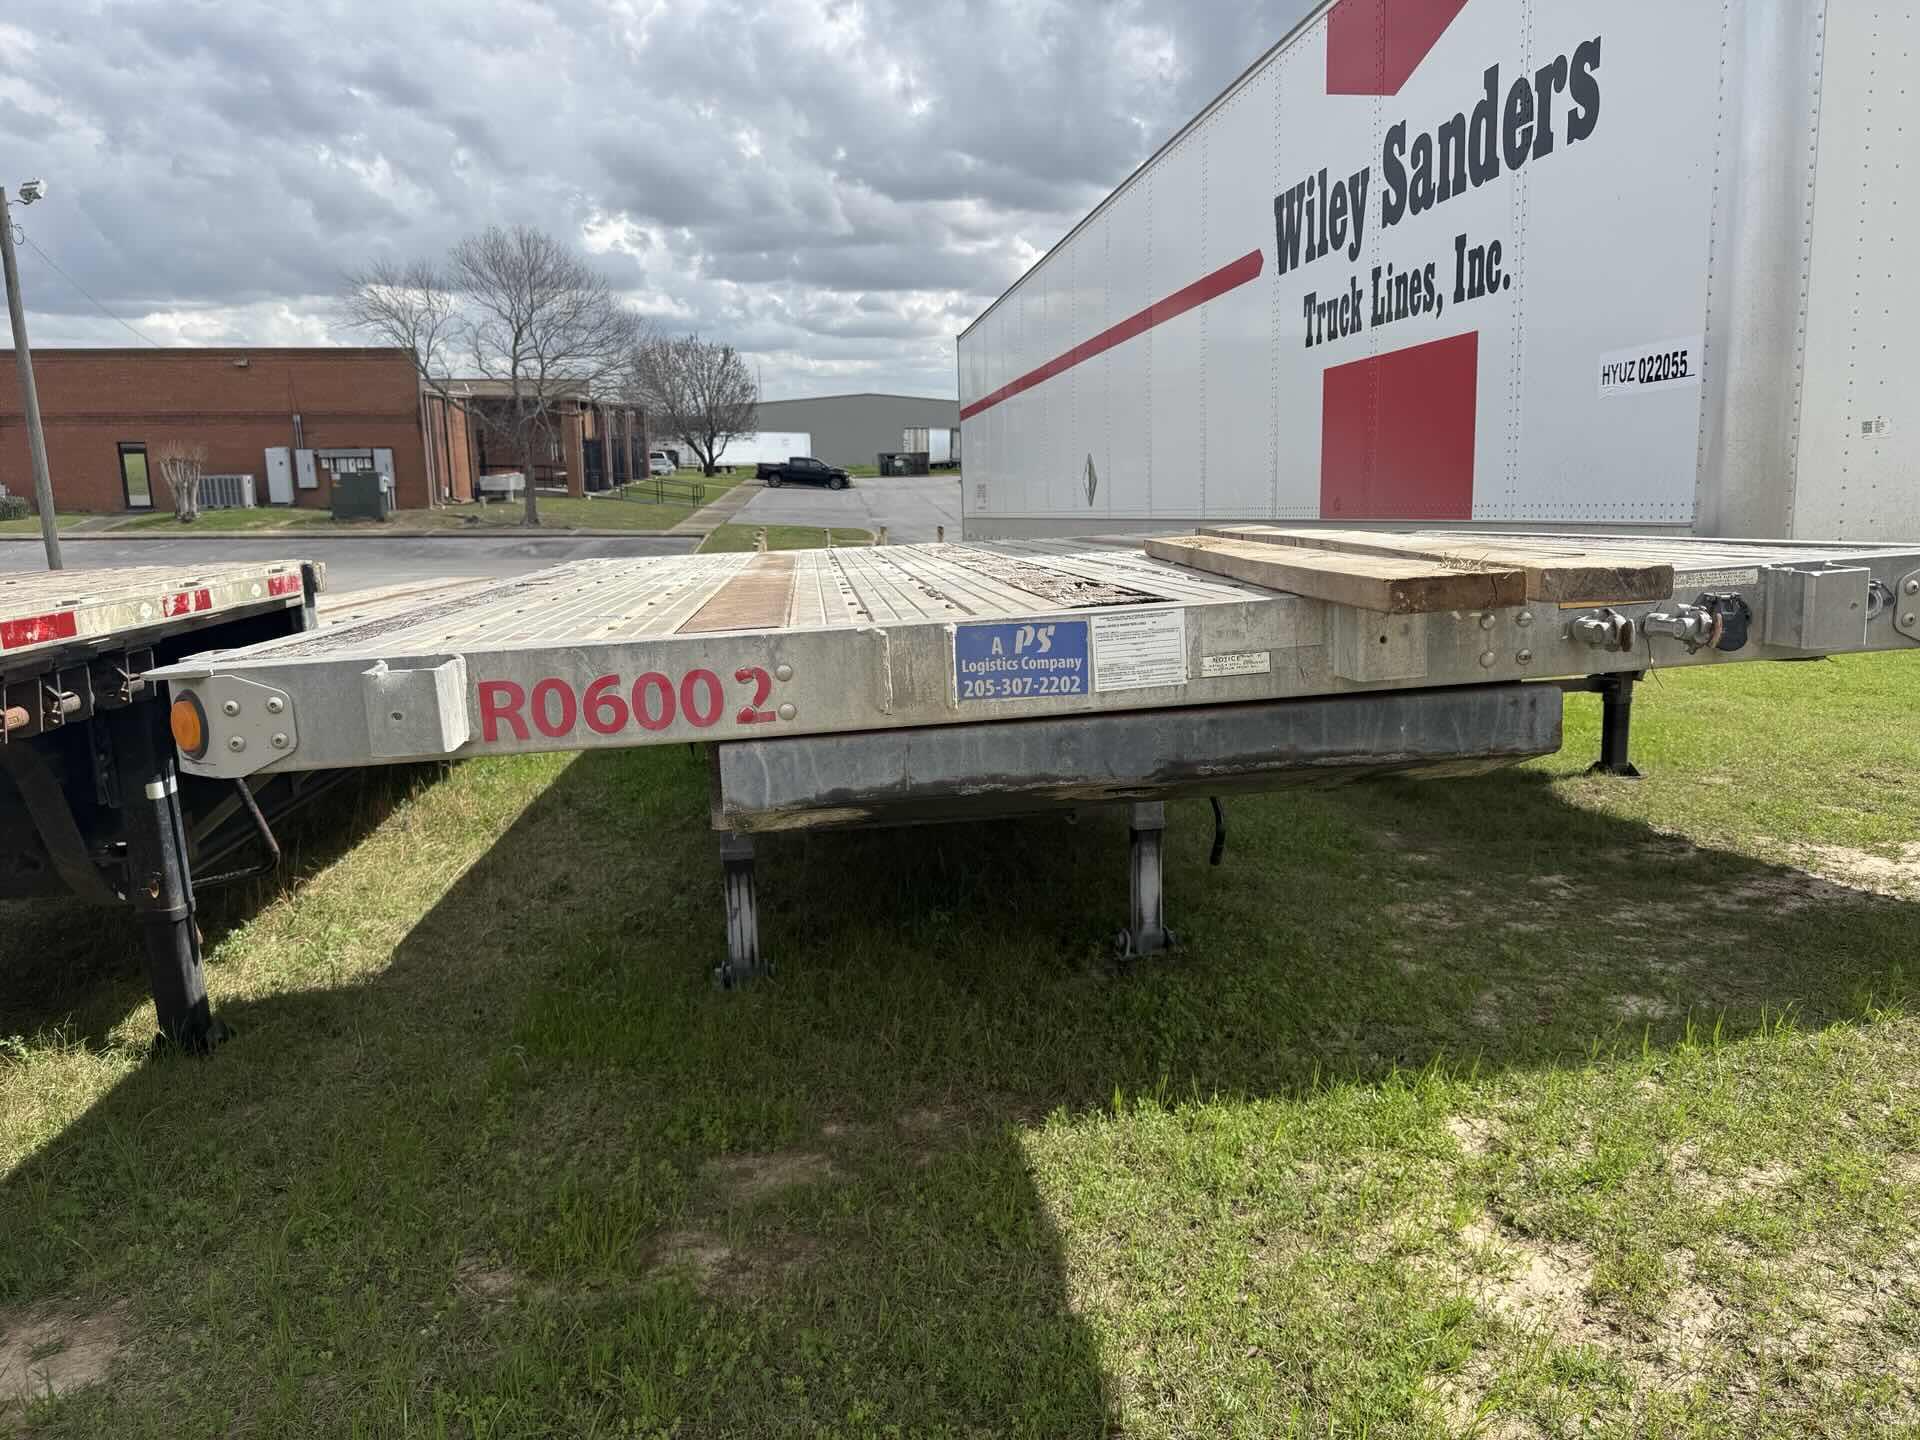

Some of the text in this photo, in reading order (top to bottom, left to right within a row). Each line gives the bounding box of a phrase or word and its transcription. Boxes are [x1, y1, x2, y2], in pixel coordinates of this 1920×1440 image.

[1273, 35, 1601, 275] Wiley Sanders
[1304, 234, 1511, 348] Truck Lines, Inc.
[1602, 350, 1688, 385] HYUZ 022055
[991, 625, 1055, 655] A PS
[962, 656, 1082, 675] Logistics Company
[963, 675, 1081, 697] 205-307-2202
[477, 666, 777, 743] R06002
